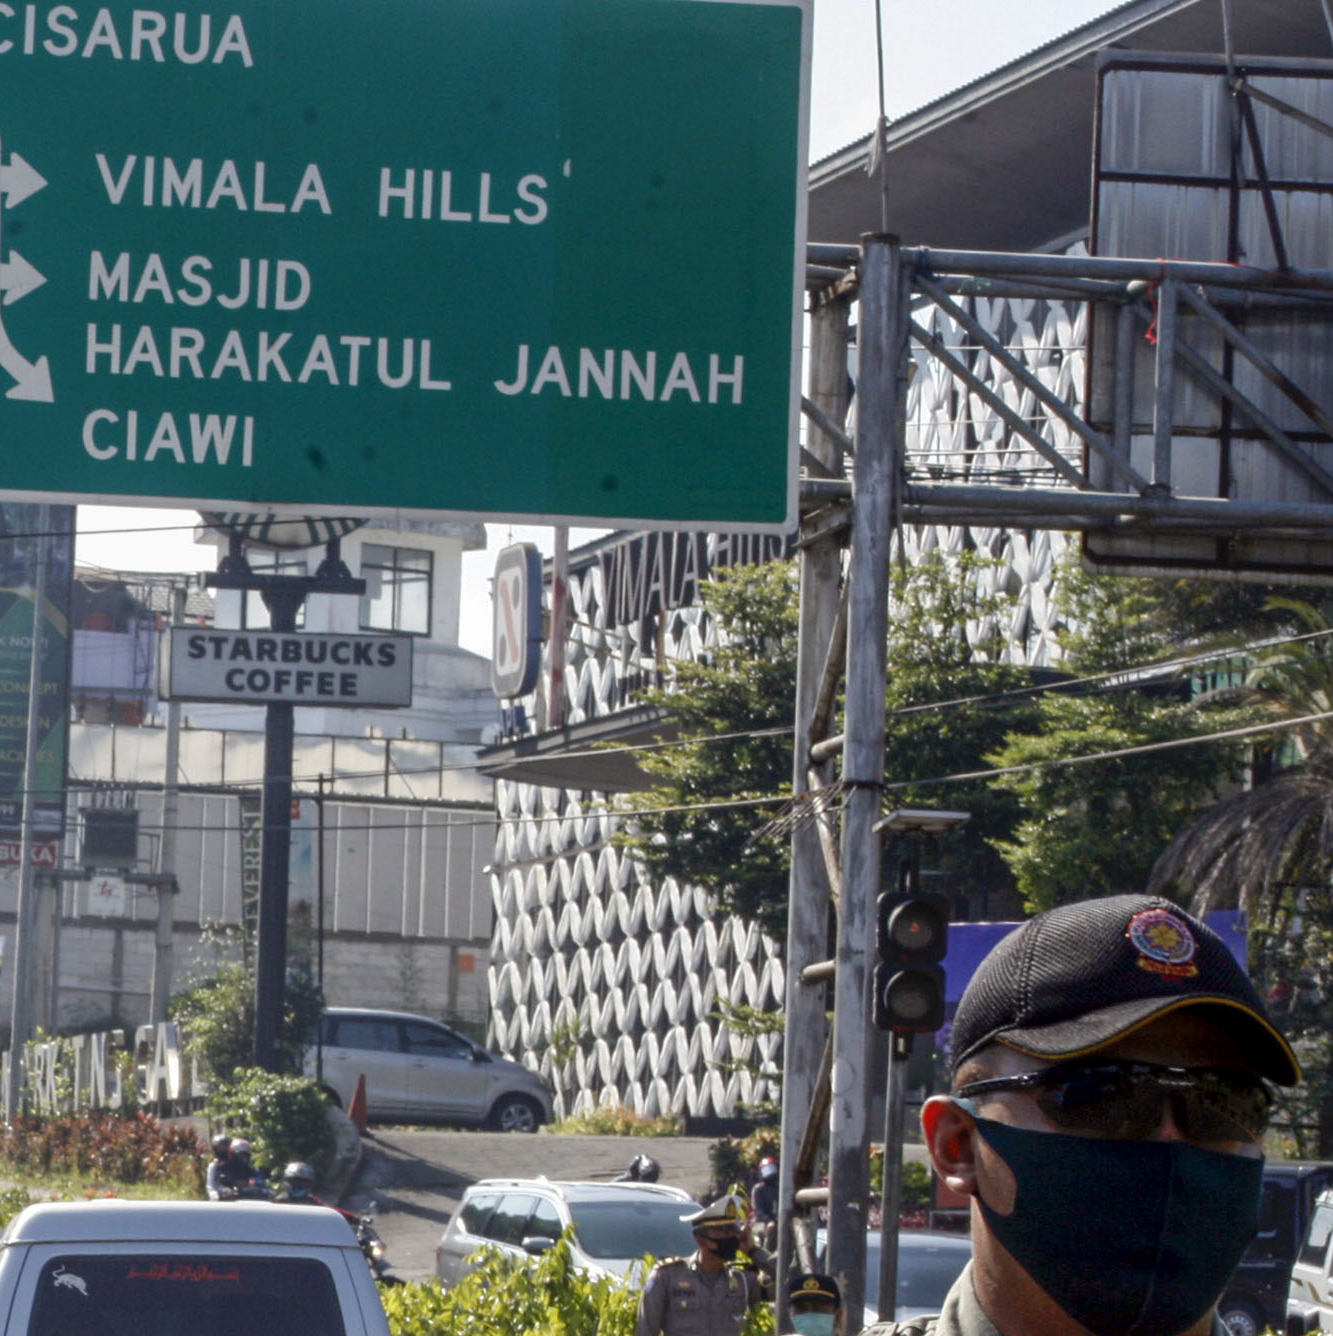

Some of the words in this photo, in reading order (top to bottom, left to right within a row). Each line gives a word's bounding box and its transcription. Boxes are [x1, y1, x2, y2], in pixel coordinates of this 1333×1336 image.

[95, 153, 332, 214] VIMALA
[88, 250, 311, 311] MASJID
[86, 323, 451, 392] HARAKATUL
[493, 346, 743, 405] JANNAH
[81, 408, 255, 467] CIAWI
[186, 632, 397, 668] STARBUCKS
[224, 665, 359, 697] COFFEE
